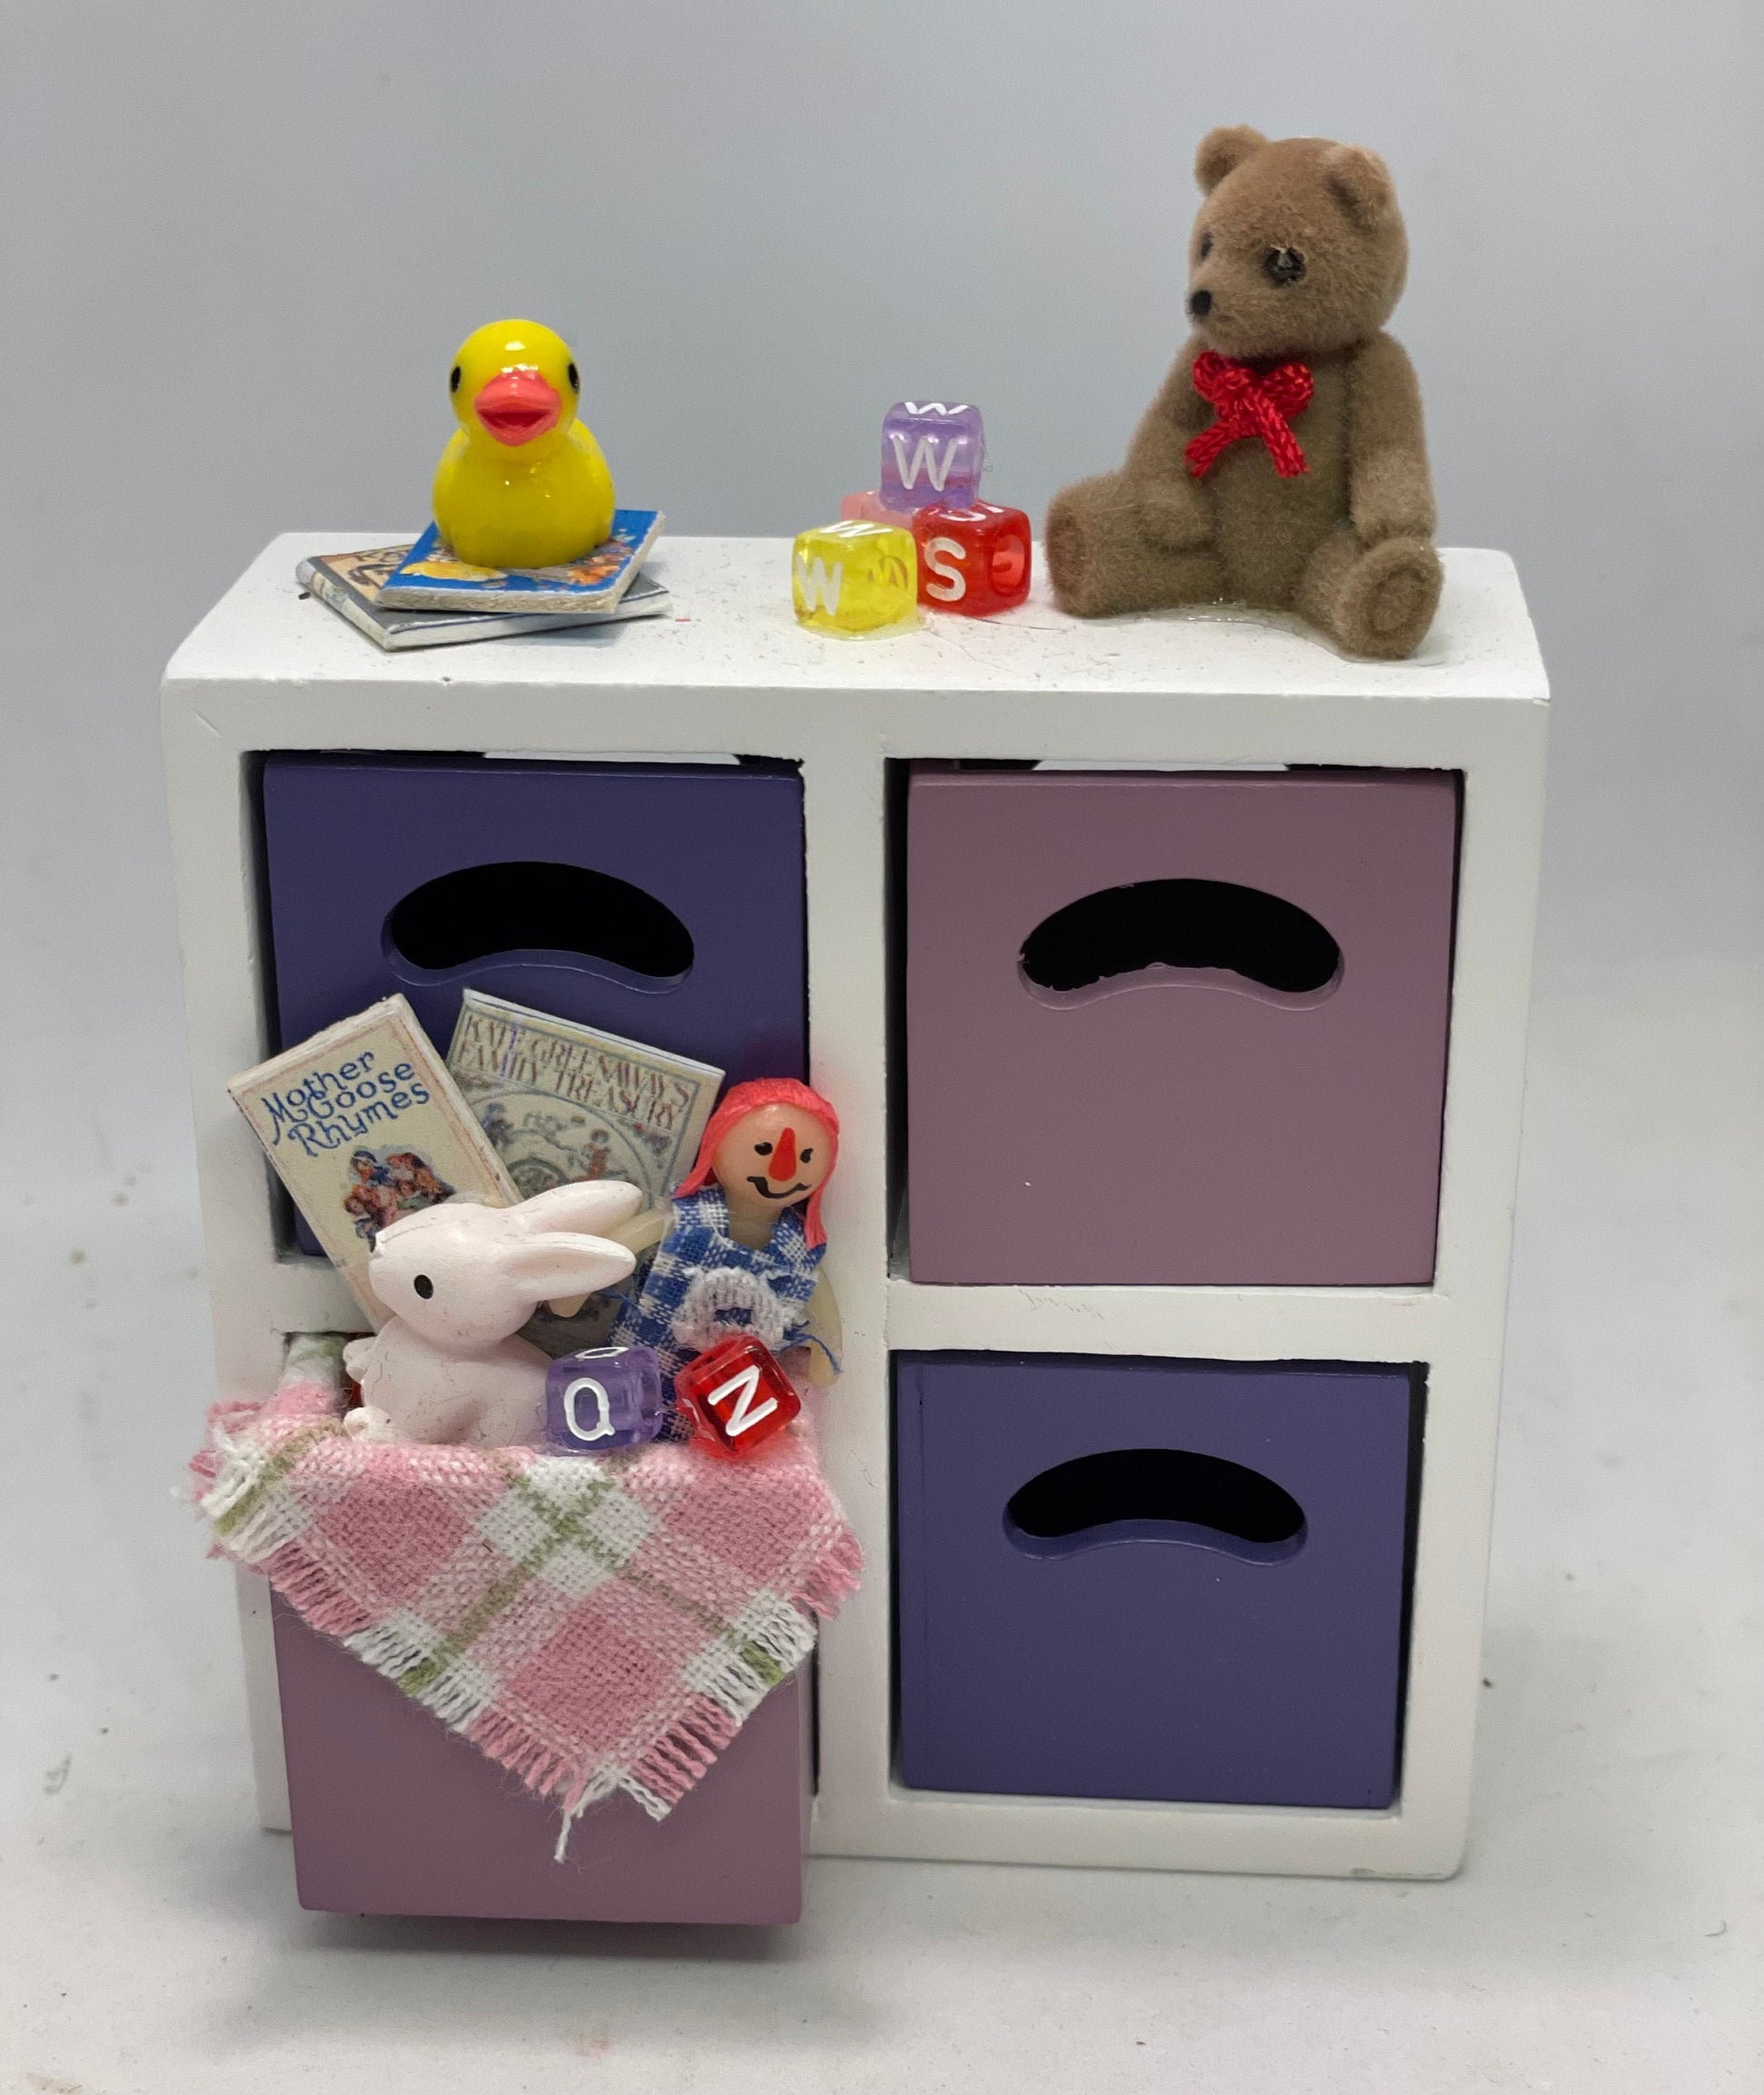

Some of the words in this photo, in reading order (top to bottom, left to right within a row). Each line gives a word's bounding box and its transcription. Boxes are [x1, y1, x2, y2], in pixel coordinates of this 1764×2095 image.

[889, 433, 964, 491] W
[796, 555, 842, 616] W
[924, 537, 966, 602] S
[261, 1050, 374, 1146] Mother
[287, 1082, 430, 1158] Rhymes
[305, 1062, 415, 1120] Goose
[563, 1377, 615, 1441] Q
